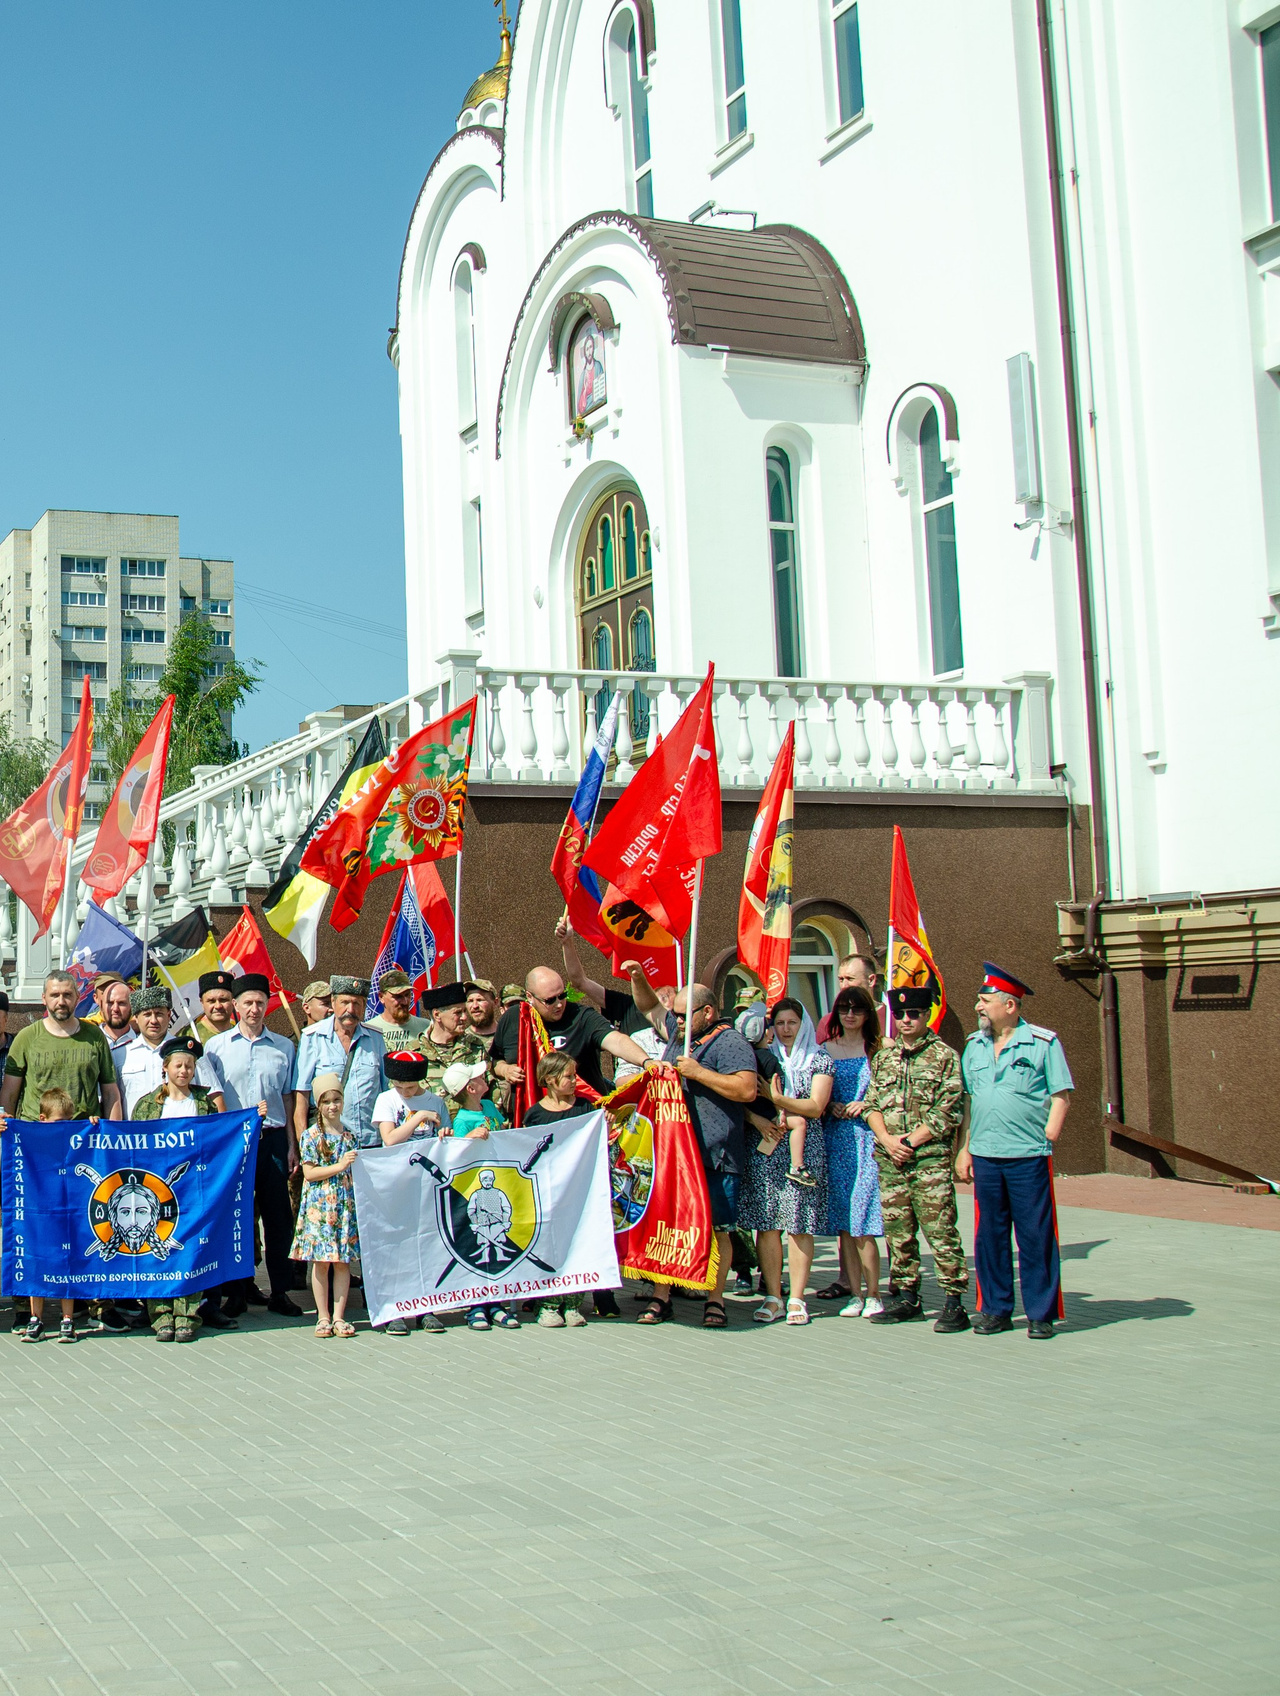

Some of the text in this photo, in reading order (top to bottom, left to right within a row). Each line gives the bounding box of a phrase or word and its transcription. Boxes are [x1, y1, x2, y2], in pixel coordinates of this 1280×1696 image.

[70, 1129, 195, 1150] С НАМИ БОГ!
[14, 1133, 25, 1282] КАЗАЧИЙ СПАС
[233, 1208, 242, 1263] ЕДИНО
[43, 1260, 219, 1285] КАЗАЧЕСТВО ВОРОНЕЖСКОЙ ОБЛАСТИ
[394, 1271, 600, 1313] ВОРОНЕЖСКОЕ КАЗАЧЕСТВО
